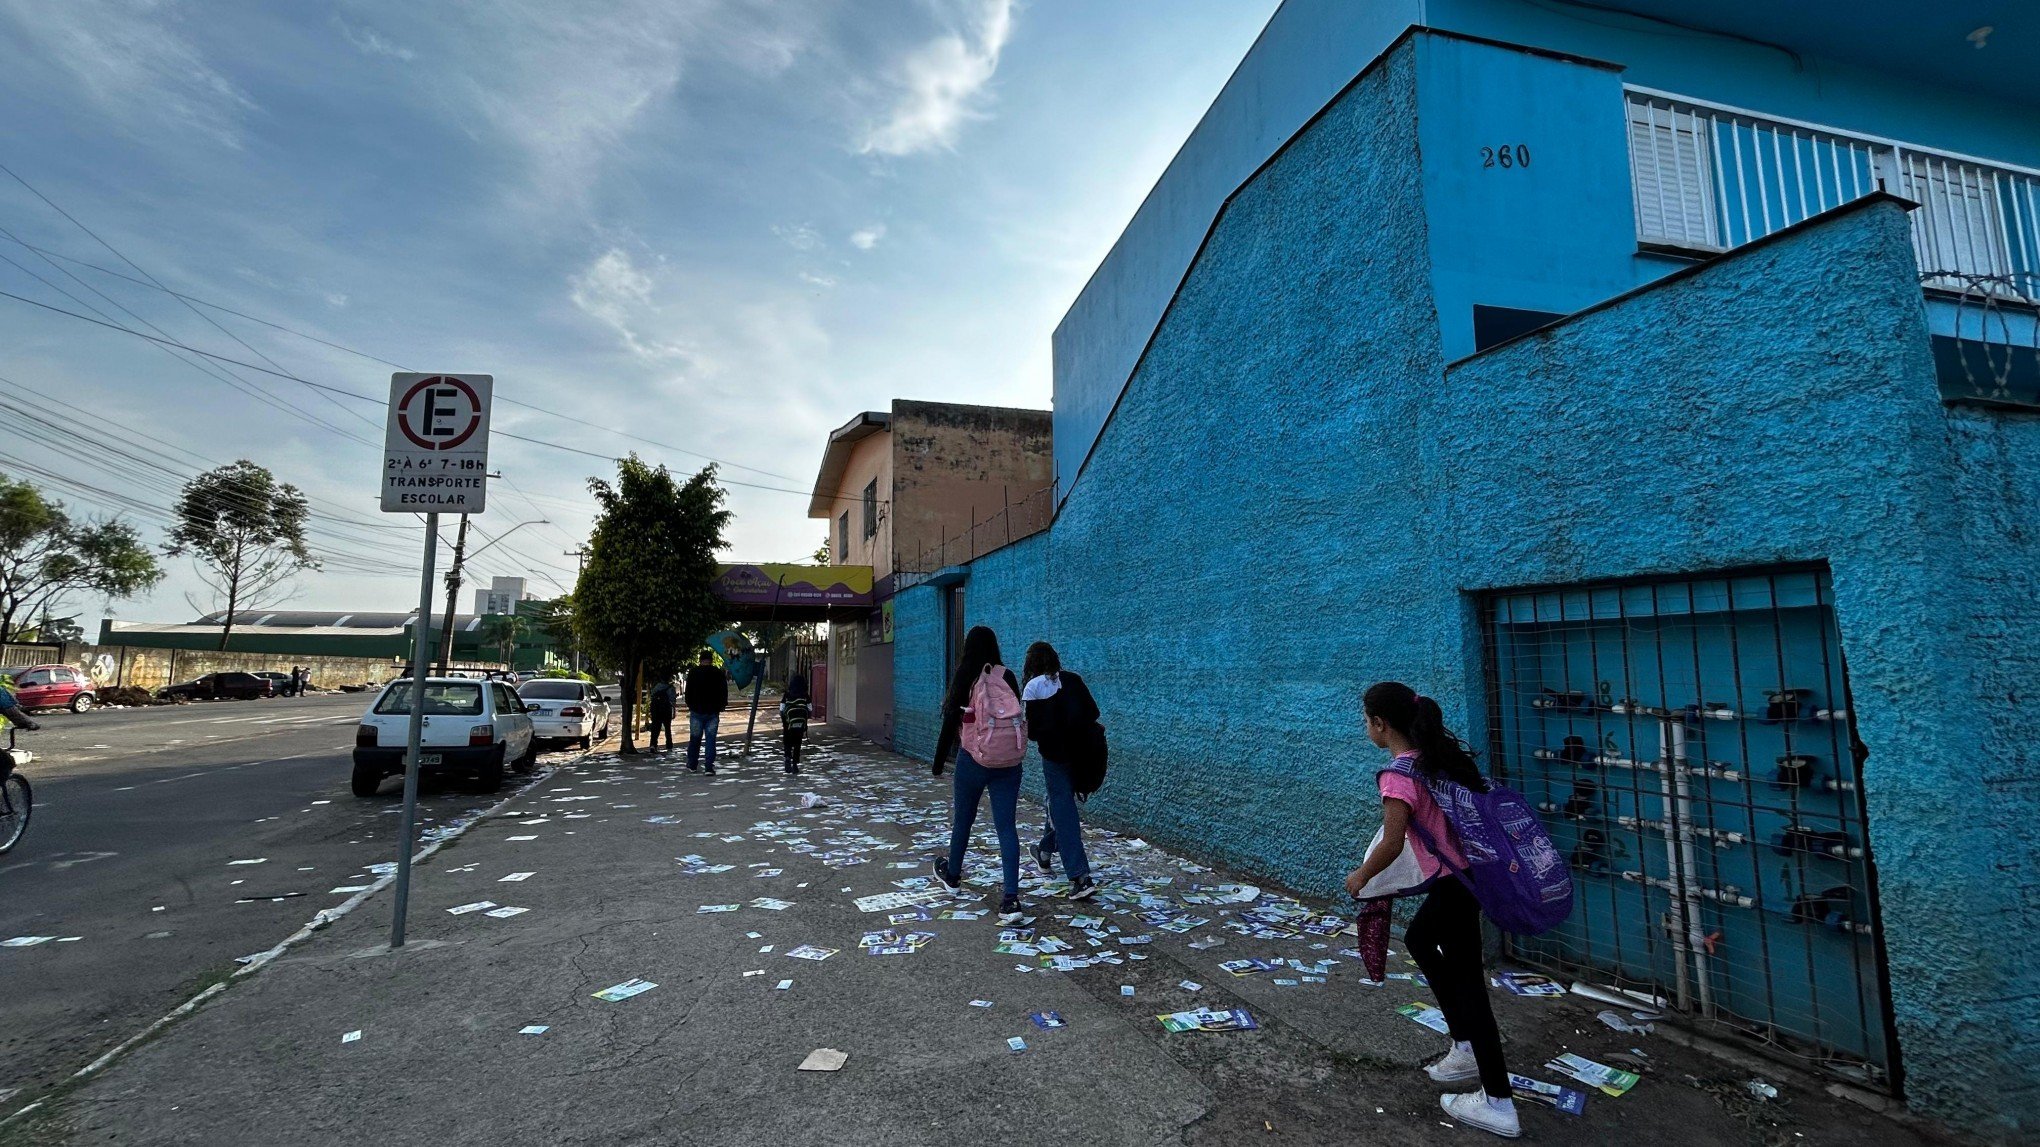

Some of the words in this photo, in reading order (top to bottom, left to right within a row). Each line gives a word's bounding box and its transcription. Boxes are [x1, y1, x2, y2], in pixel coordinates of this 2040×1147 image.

[1480, 144, 1530, 169] 260
[389, 476, 480, 488] TRANSPORTE
[401, 493, 465, 505] ESCOLAR
